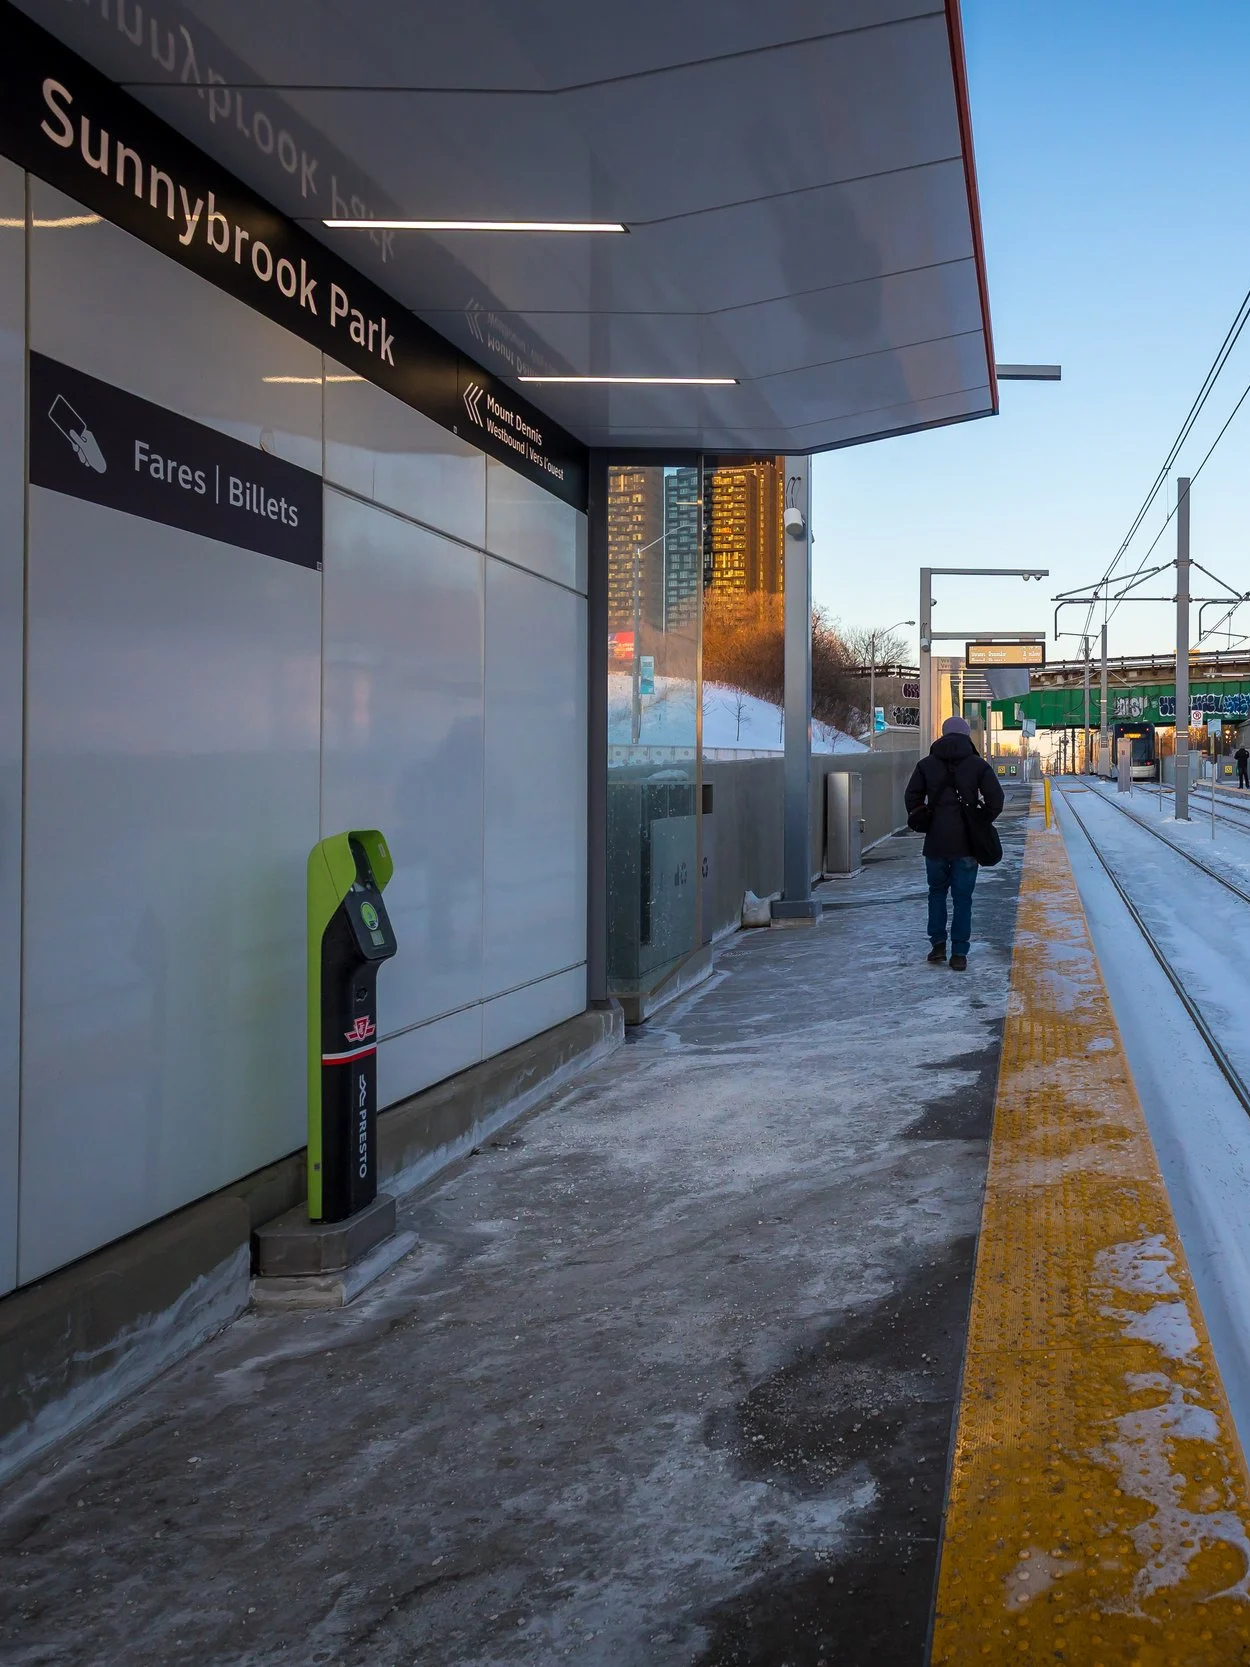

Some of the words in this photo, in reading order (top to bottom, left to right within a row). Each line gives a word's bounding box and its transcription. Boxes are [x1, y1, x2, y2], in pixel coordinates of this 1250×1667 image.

[40, 77, 319, 316] Sunnybrook
[330, 282, 395, 367] Park
[486, 417, 525, 454] Westbound
[529, 446, 543, 467] Vers
[544, 456, 565, 481] l'ouest
[487, 394, 514, 426] Mount
[515, 414, 543, 446] Dennis
[134, 439, 206, 495] Fares
[229, 476, 298, 527] Billets
[359, 1109, 367, 1179] PRESTO
